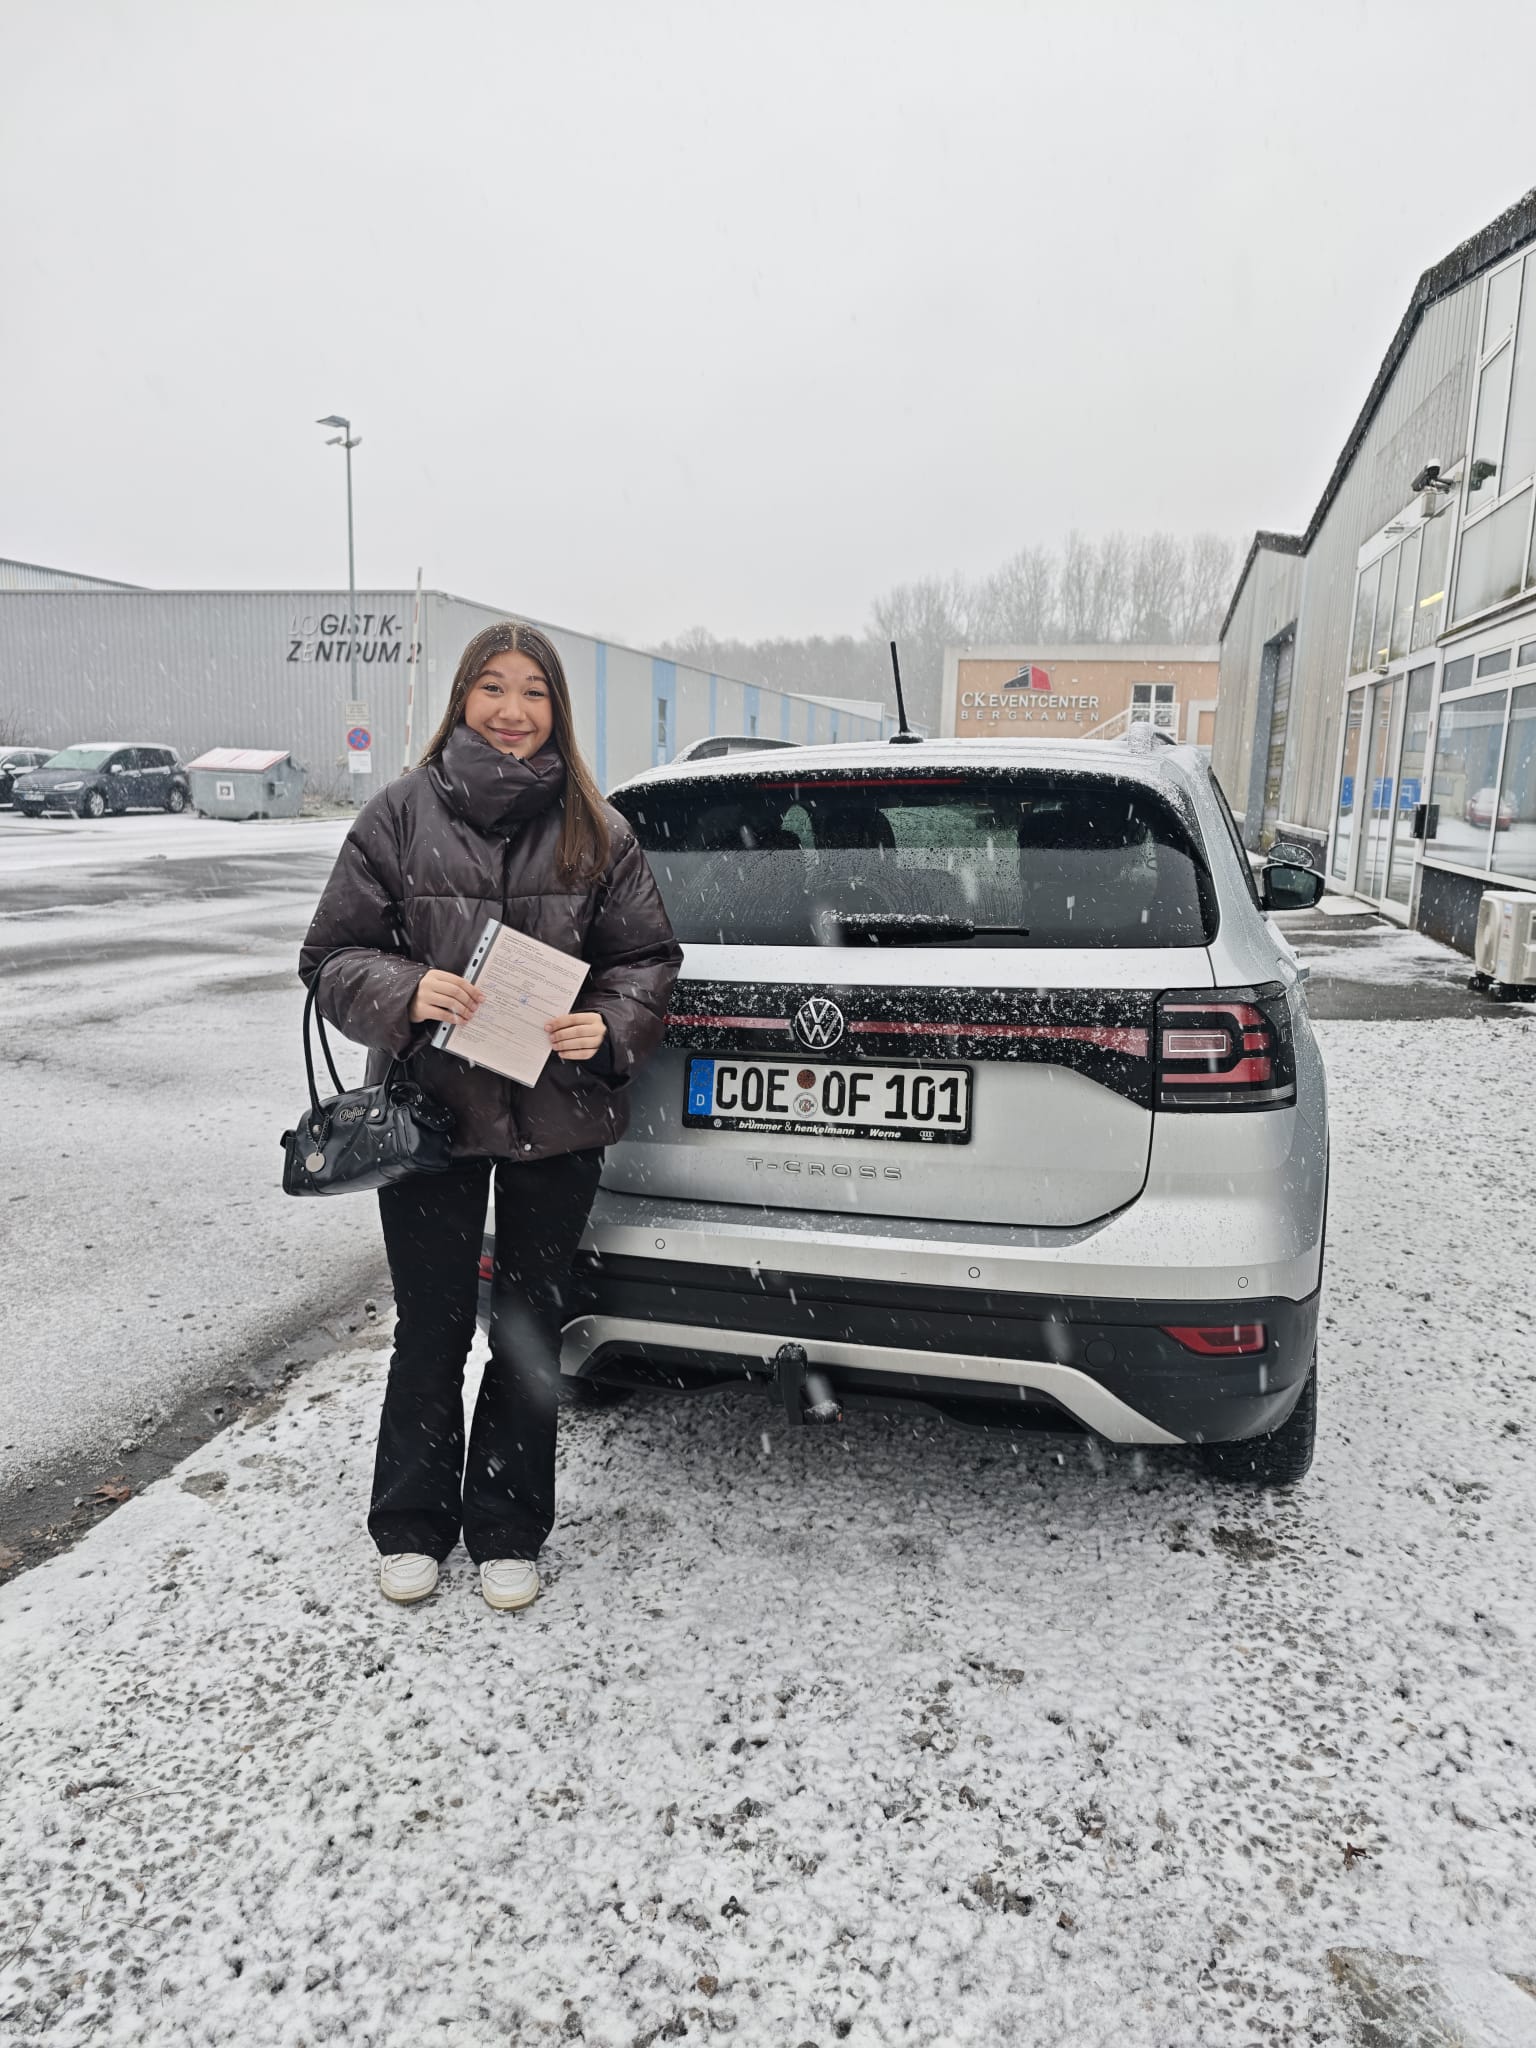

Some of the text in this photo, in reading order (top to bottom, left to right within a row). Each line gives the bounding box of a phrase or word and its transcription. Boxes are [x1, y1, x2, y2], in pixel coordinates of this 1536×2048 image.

[406, 641, 422, 663] 2
[961, 692, 1099, 709] CK EVENTCENTER
[960, 711, 1099, 721] BERGKAMEN
[696, 1067, 962, 1123] D COE OF 101
[738, 1119, 902, 1139] brümmer & henkelmann Werne
[747, 1157, 902, 1181] T-CROSS
